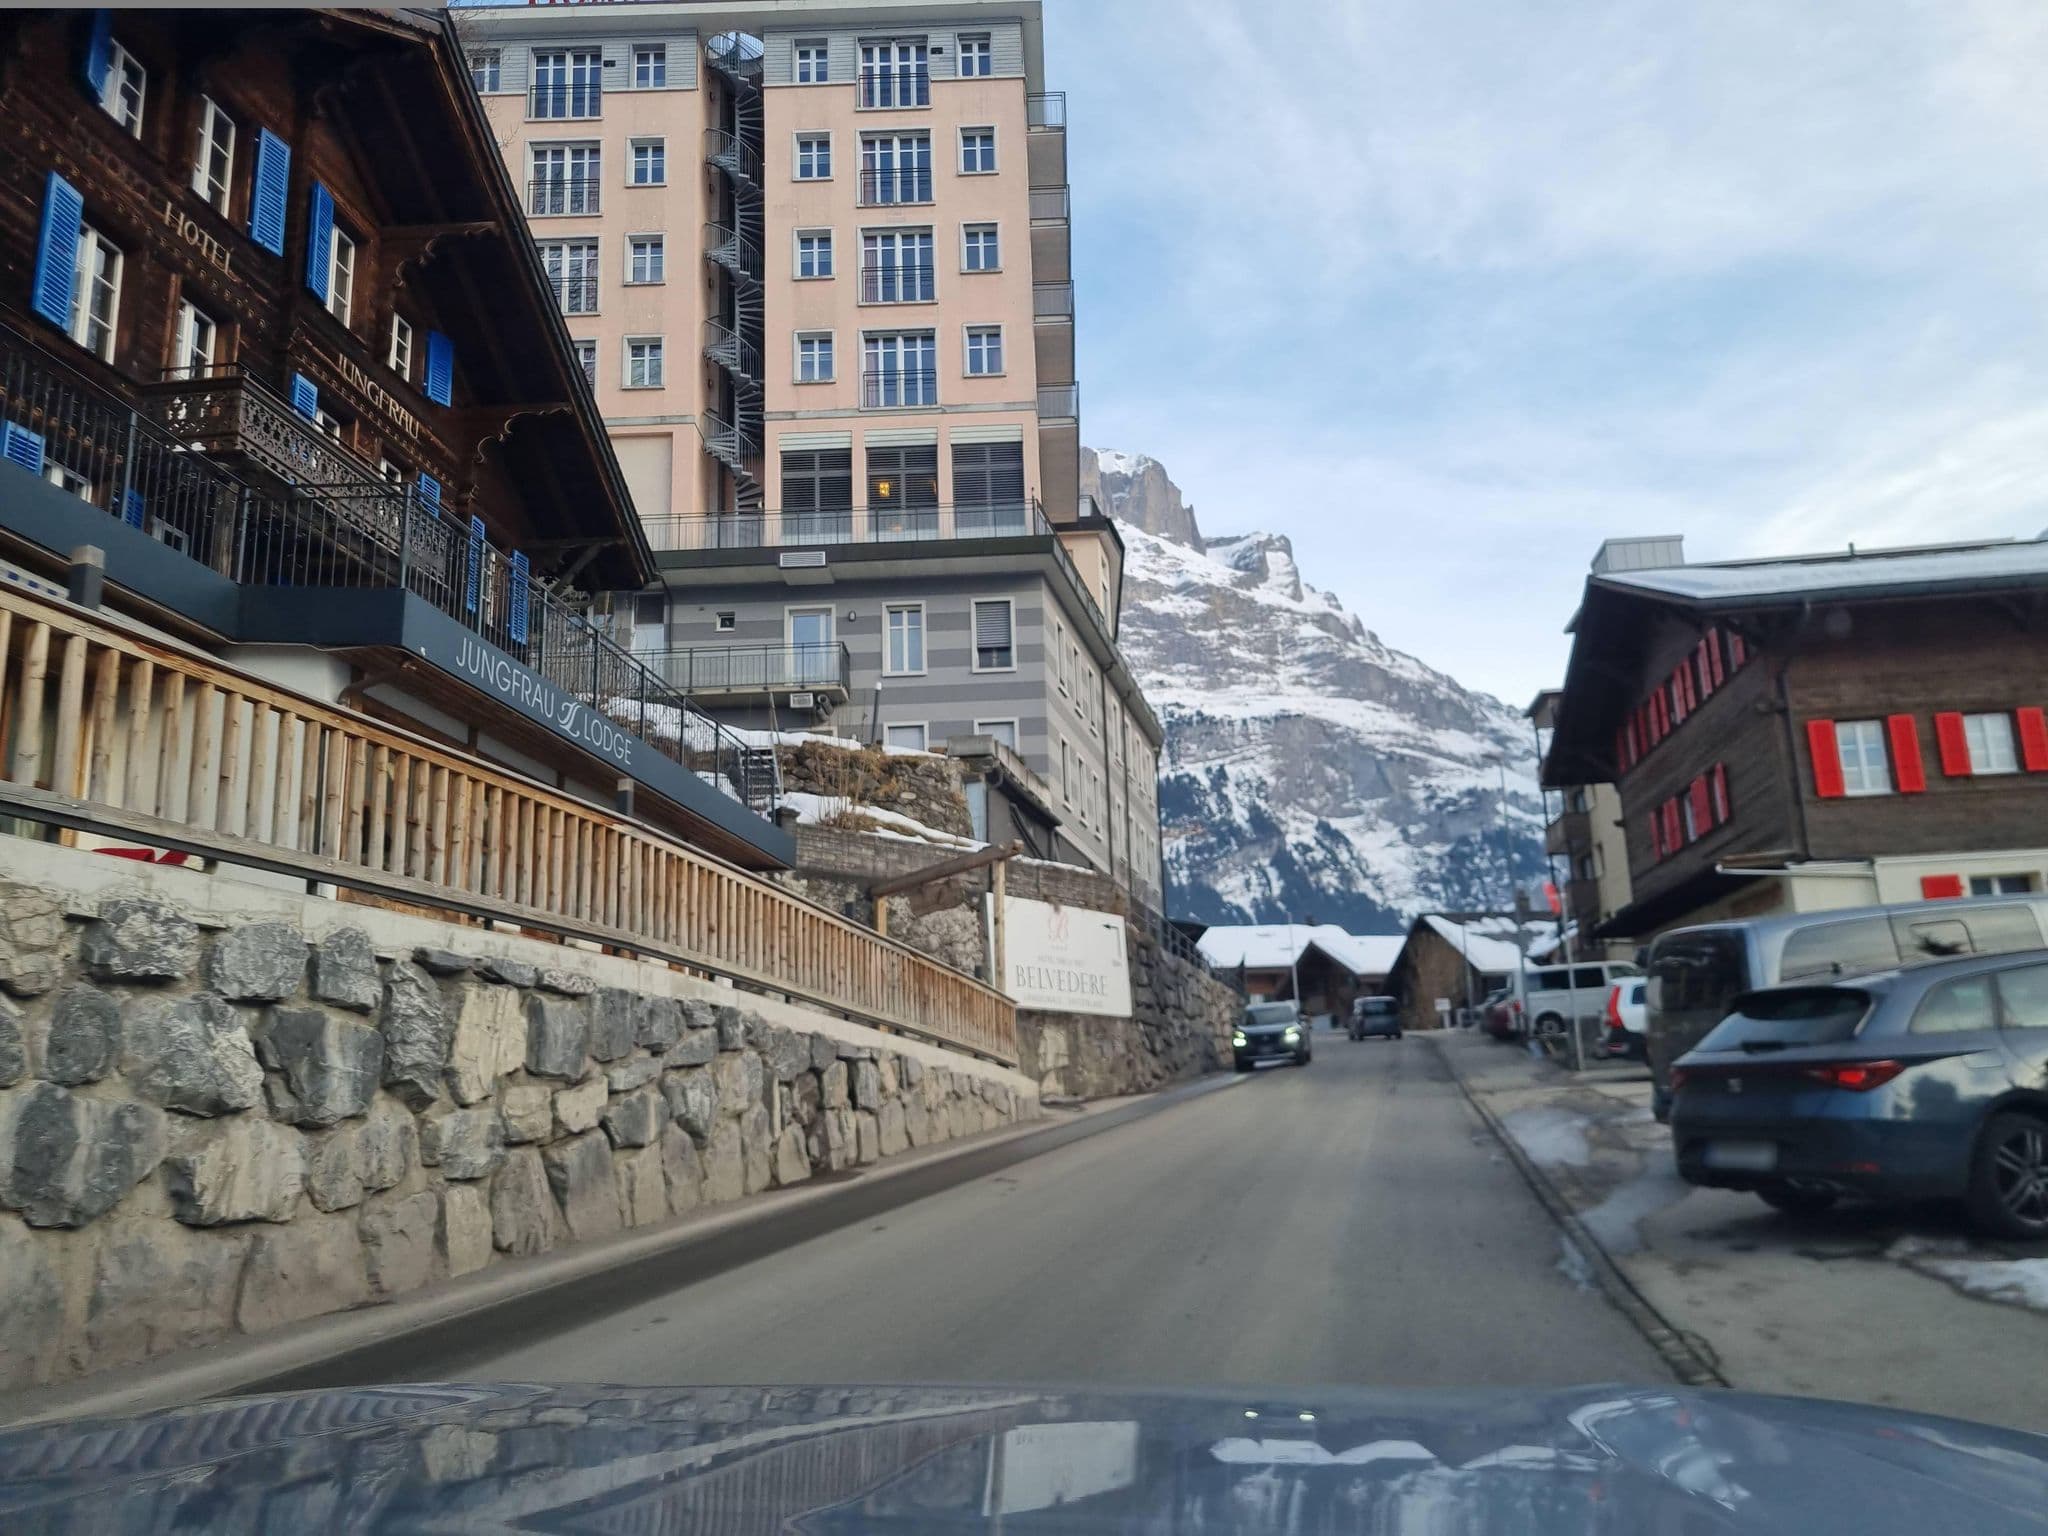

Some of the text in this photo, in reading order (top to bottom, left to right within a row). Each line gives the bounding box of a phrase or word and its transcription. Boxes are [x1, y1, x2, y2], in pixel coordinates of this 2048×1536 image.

[162, 201, 233, 276] HOTEL
[456, 637, 555, 718] JUNGFRAU
[584, 713, 632, 765] LODGE
[1015, 964, 1109, 996] BELVEDERE
